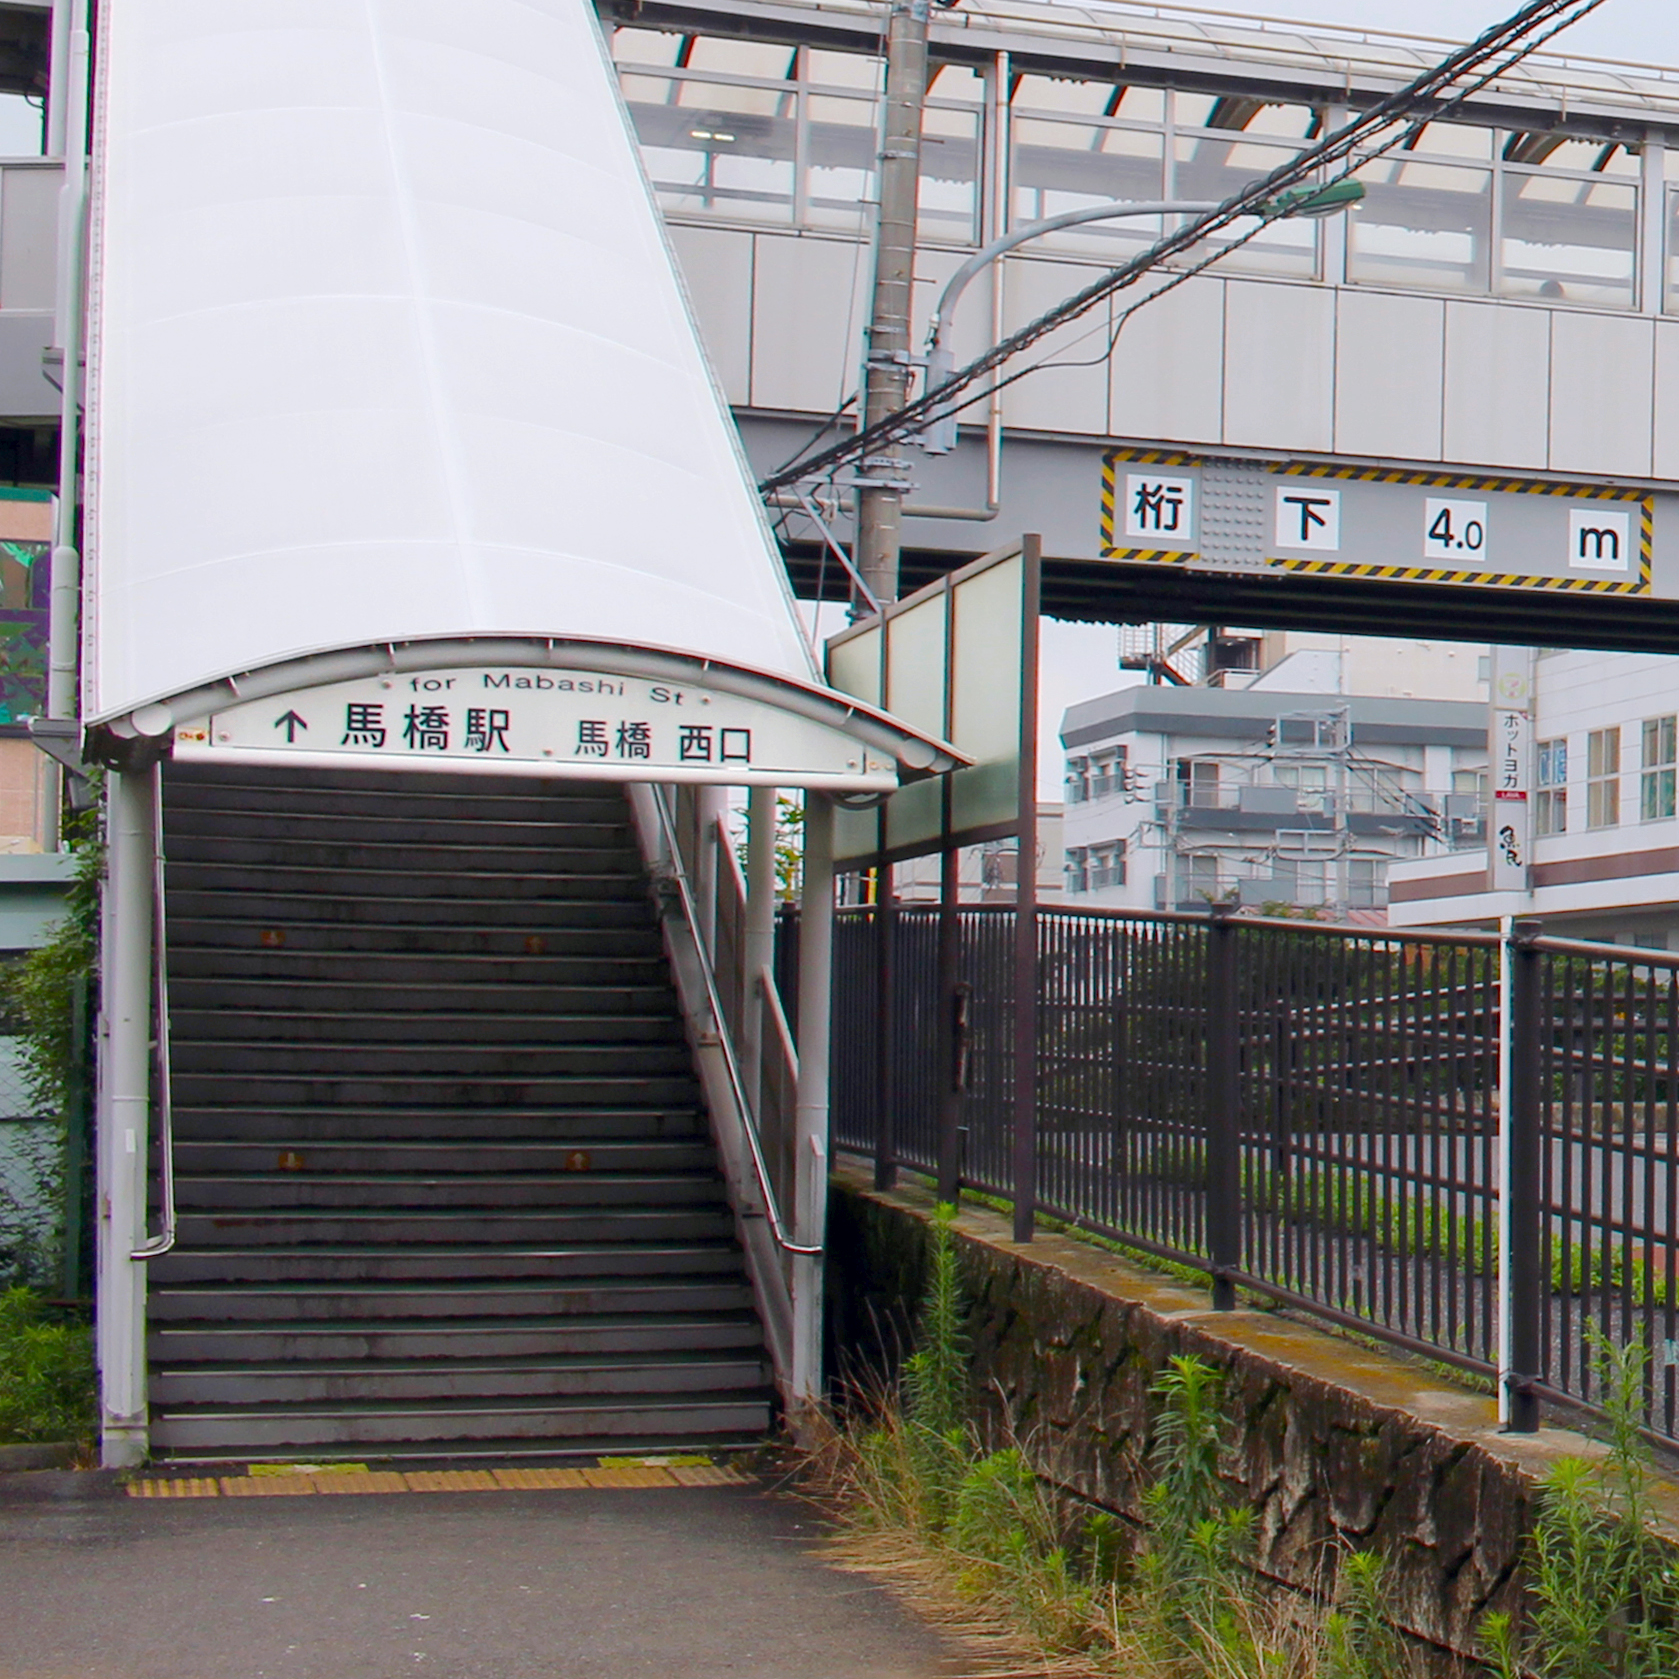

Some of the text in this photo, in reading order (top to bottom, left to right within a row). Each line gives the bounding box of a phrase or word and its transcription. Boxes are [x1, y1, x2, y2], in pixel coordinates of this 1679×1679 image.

[1428, 507, 1485, 551] 4.0
[1579, 526, 1620, 561] m
[410, 673, 685, 707] for Mabashi St
[341, 702, 753, 764] 馬橋駅 馬橋 西口
[1504, 714, 1521, 789] ホットヨガ
